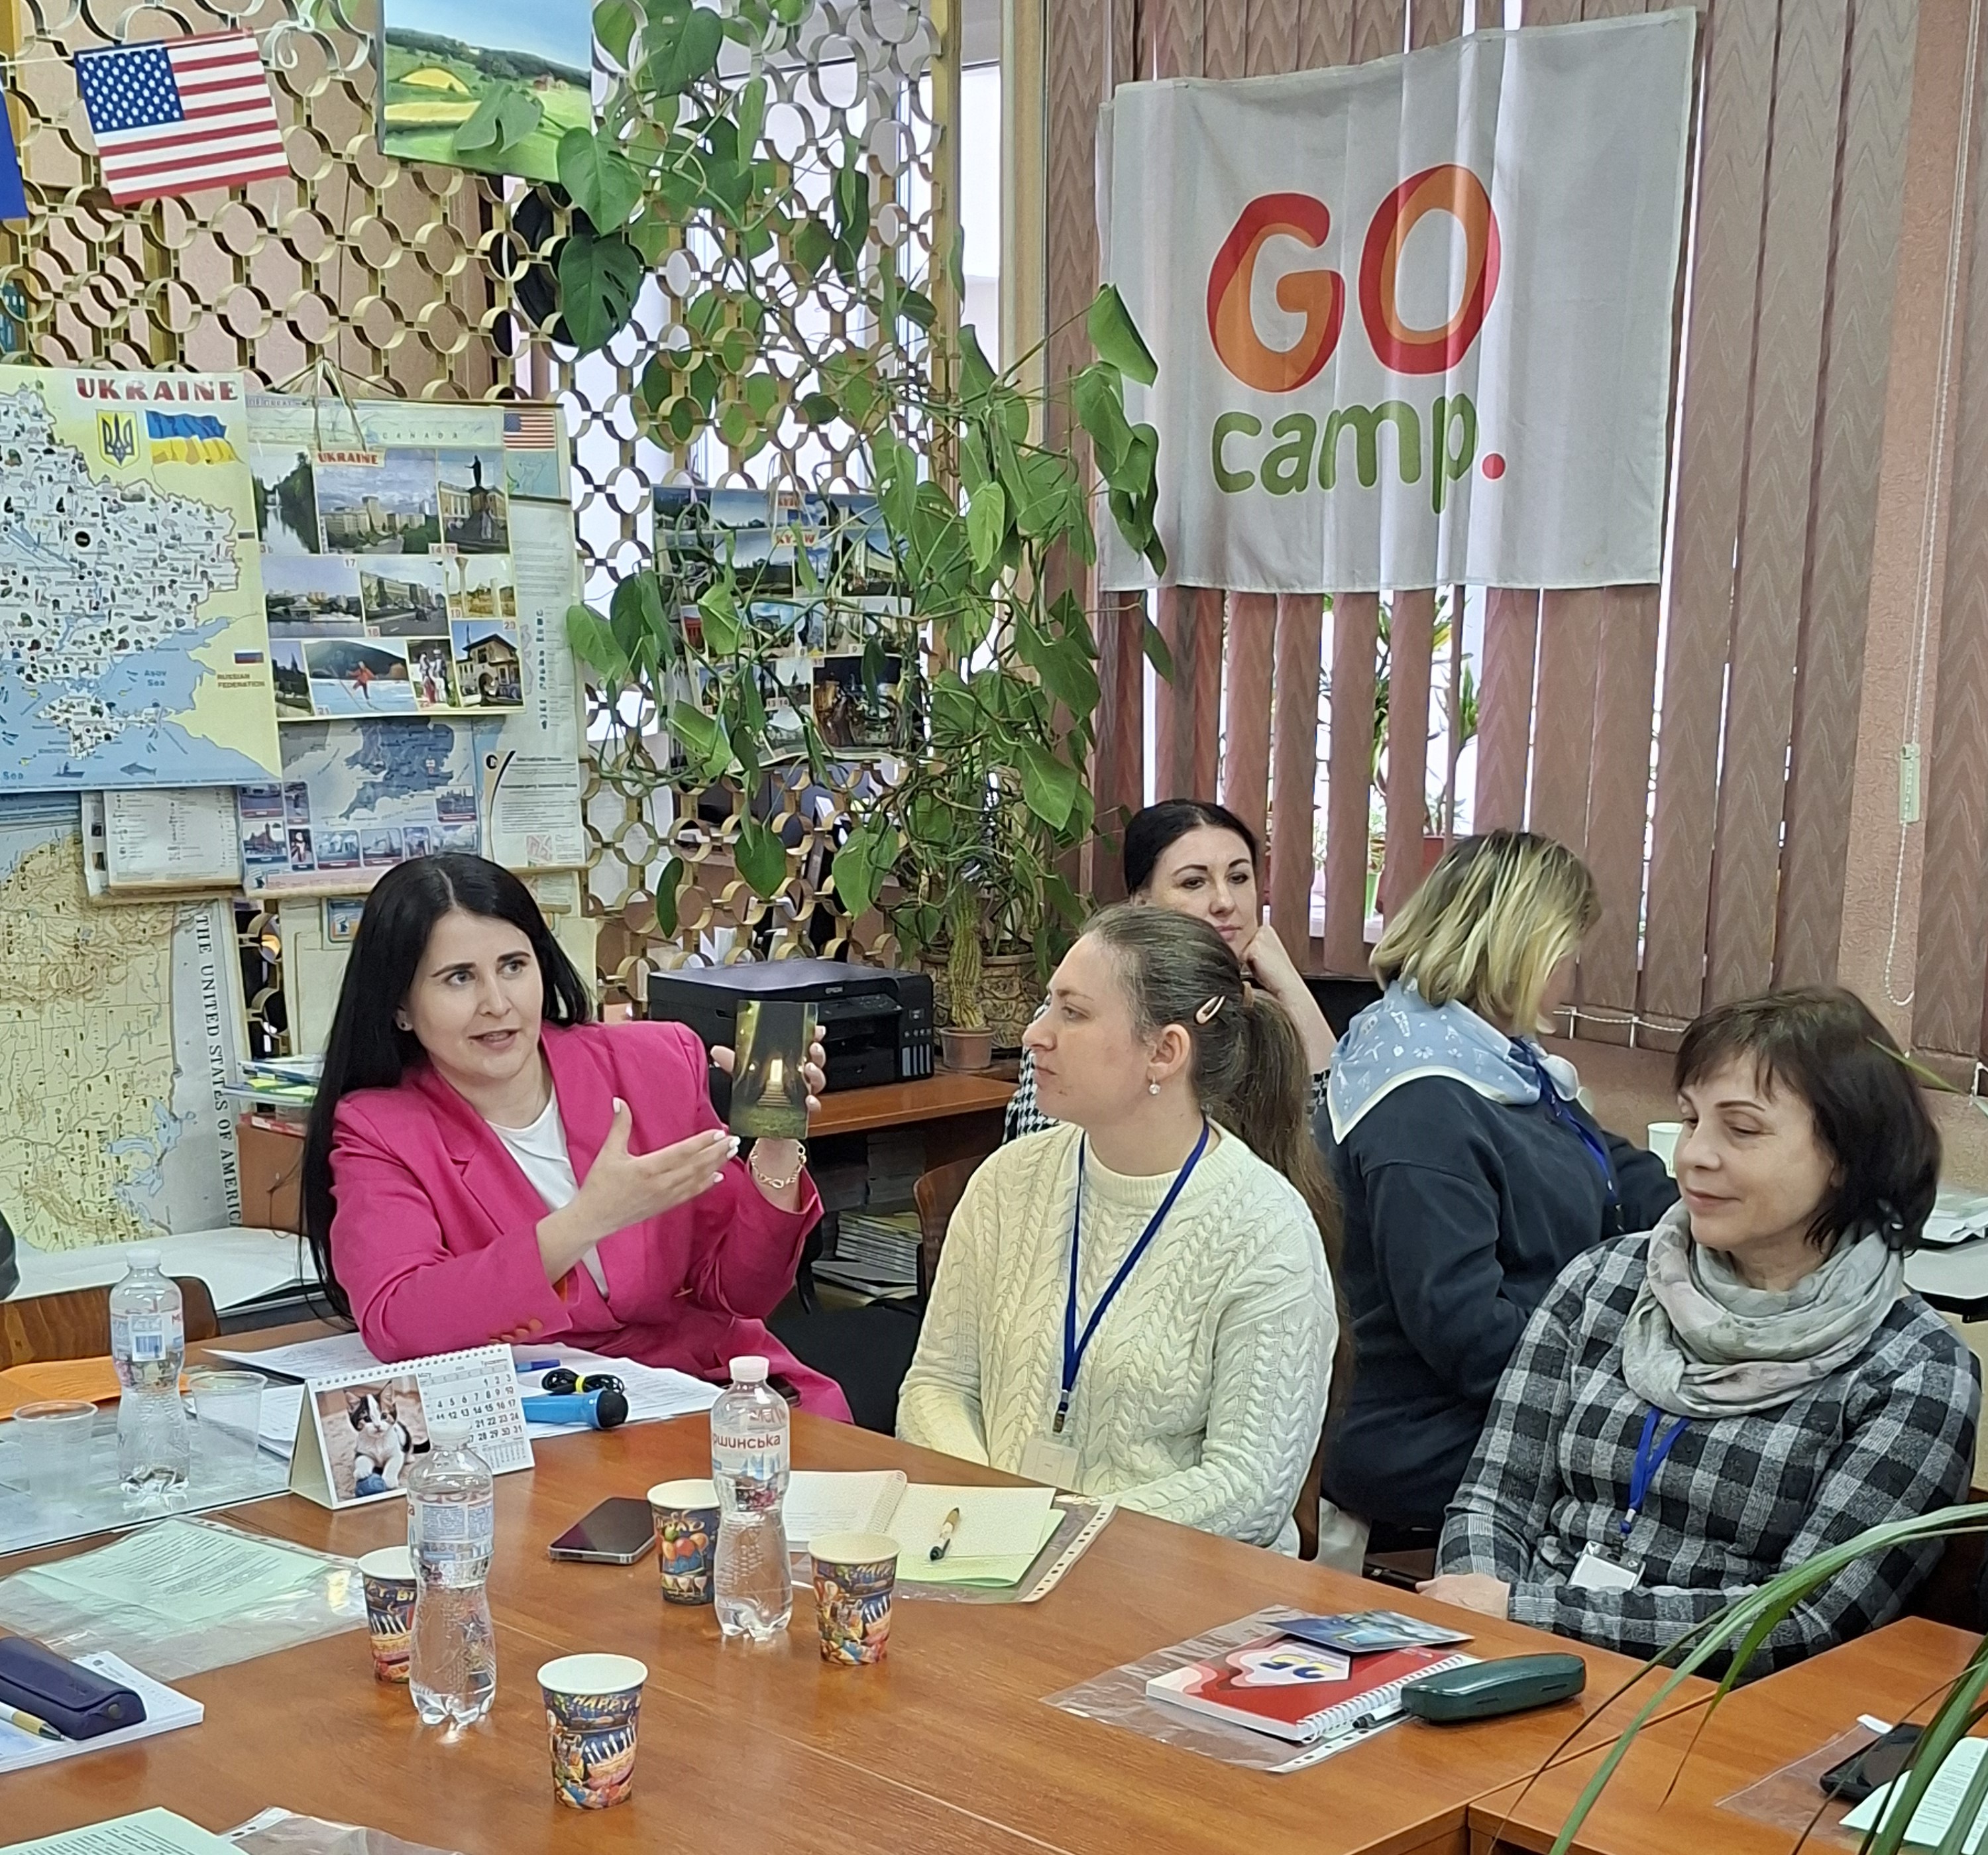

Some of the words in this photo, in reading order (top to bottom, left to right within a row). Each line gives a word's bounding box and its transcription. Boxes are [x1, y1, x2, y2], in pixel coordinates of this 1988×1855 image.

[1207, 163, 1502, 393] GO
[76, 377, 239, 402] UKRAINE
[382, 431, 459, 440] CANADA
[318, 452, 379, 465] UKRAINE
[345, 559, 356, 567] 17
[195, 915, 213, 954] THE
[200, 964, 221, 1037] UNITED
[209, 1044, 229, 1112] STATES
[217, 1118, 233, 1142] OF
[484, 1378, 488, 1386] 1
[494, 1376, 500, 1384] 2
[506, 1374, 512, 1382] 3
[449, 1397, 455, 1406] 5
[462, 1395, 467, 1404] 6
[474, 1392, 478, 1402] 7
[486, 1390, 491, 1399] 8
[461, 1408, 469, 1417] 13
[484, 1404, 494, 1412] 15
[508, 1399, 516, 1408] 17
[475, 1419, 484, 1428] 21
[487, 1417, 496, 1426] 22
[499, 1414, 508, 1423] 23
[478, 1432, 486, 1441] 28
[490, 1430, 498, 1438] 29
[573, 1695, 631, 1712] HAPPY
